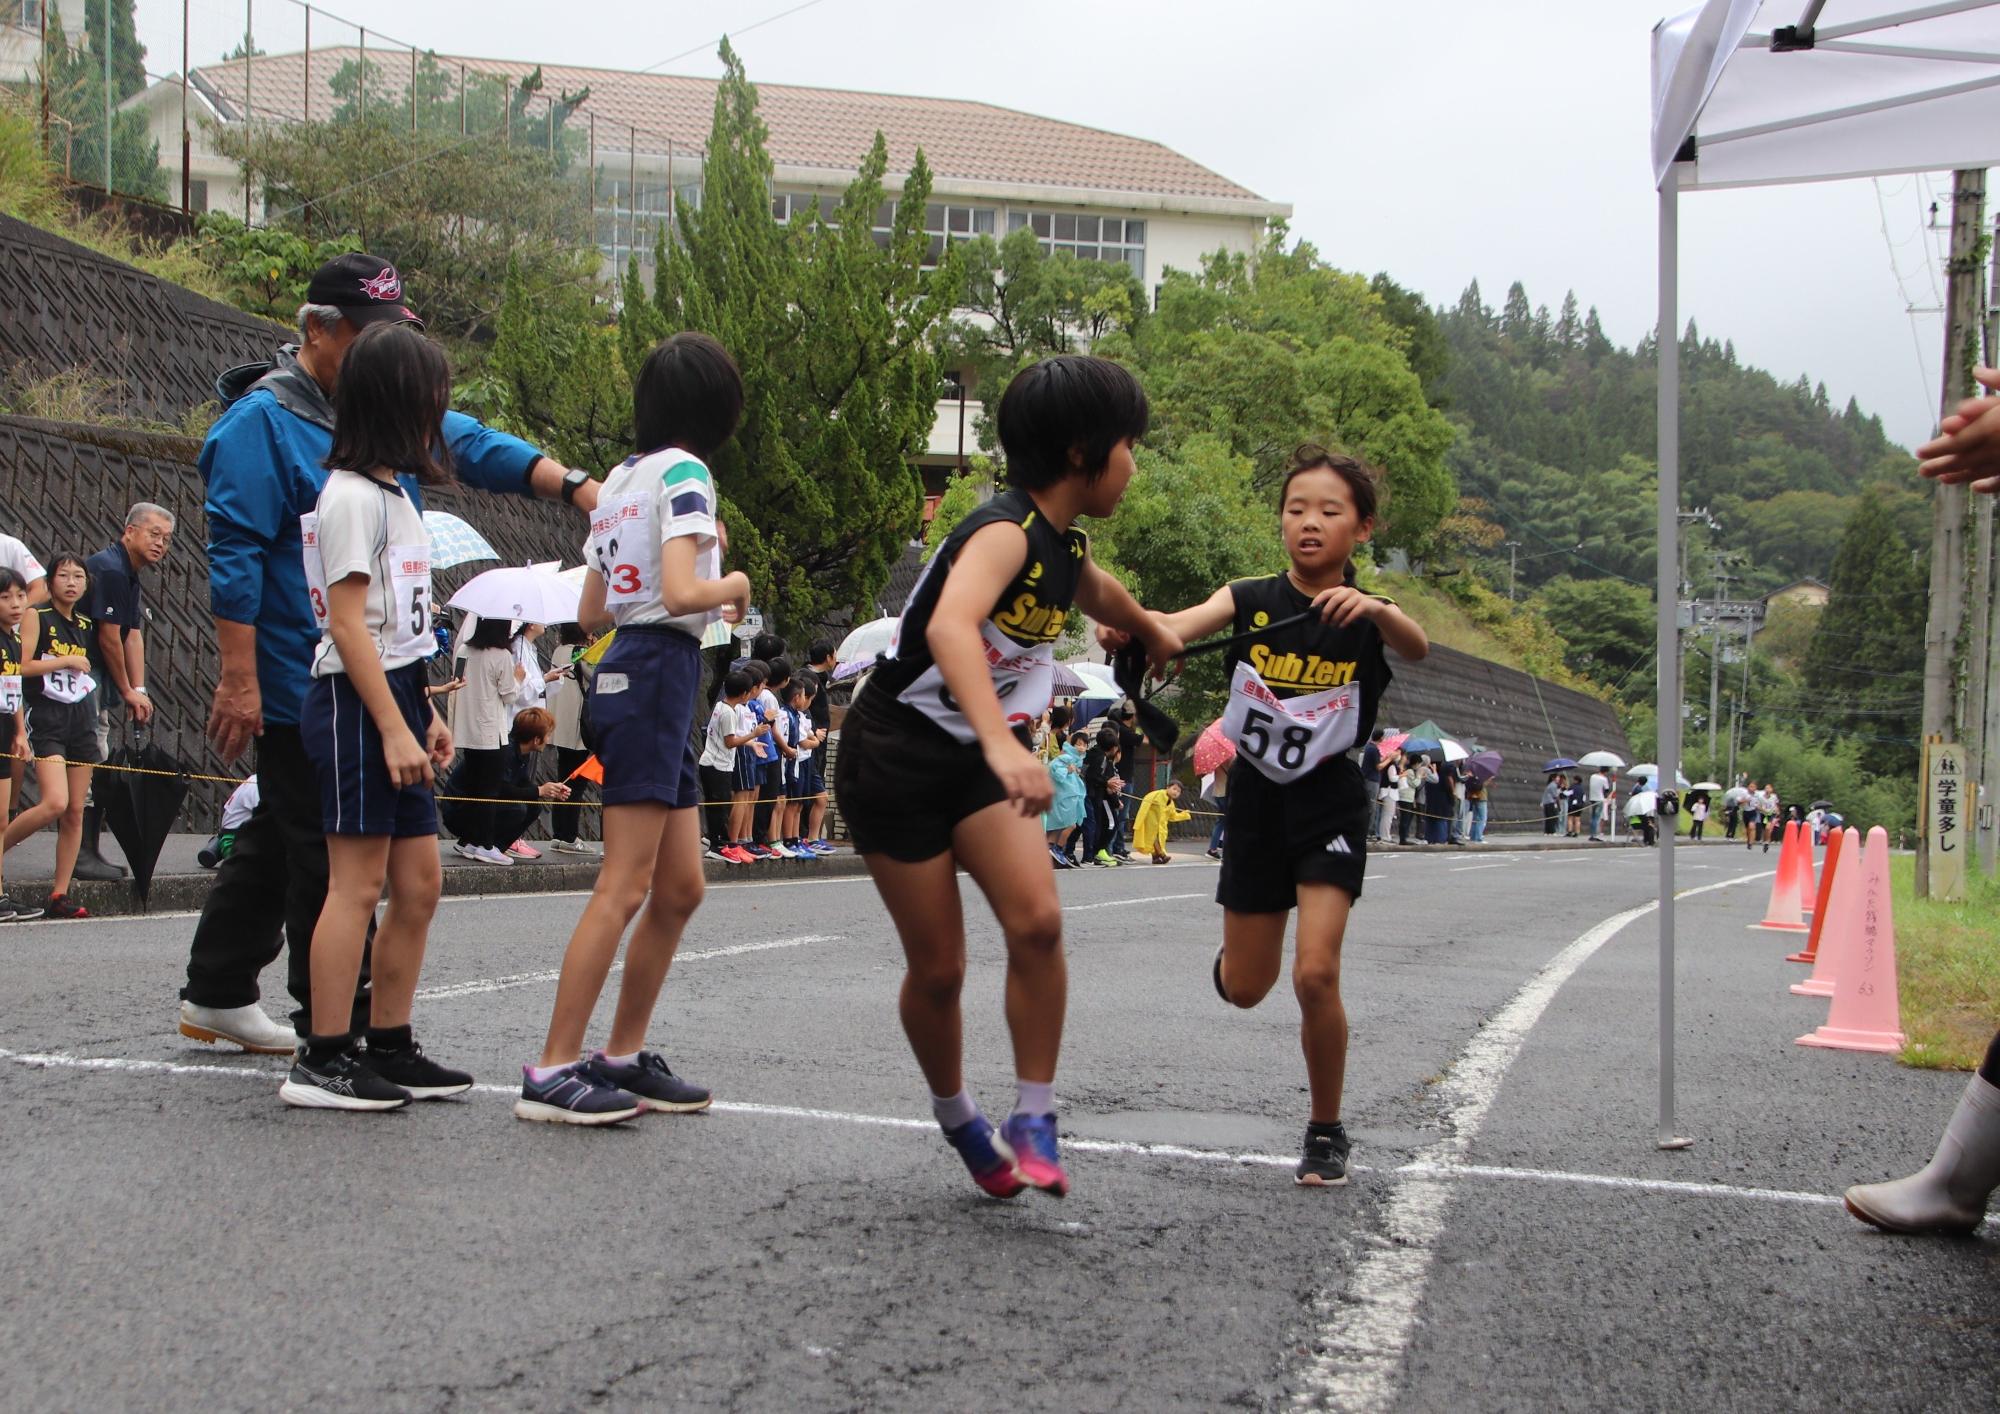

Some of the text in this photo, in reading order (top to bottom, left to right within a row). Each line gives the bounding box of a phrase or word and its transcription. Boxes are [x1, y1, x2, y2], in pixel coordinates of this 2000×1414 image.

[612, 563, 643, 594] 3
[310, 587, 327, 618] 3
[1250, 643, 1304, 682] Sub
[1239, 707, 1313, 769] 58
[1937, 779, 1957, 852] 学童多し
